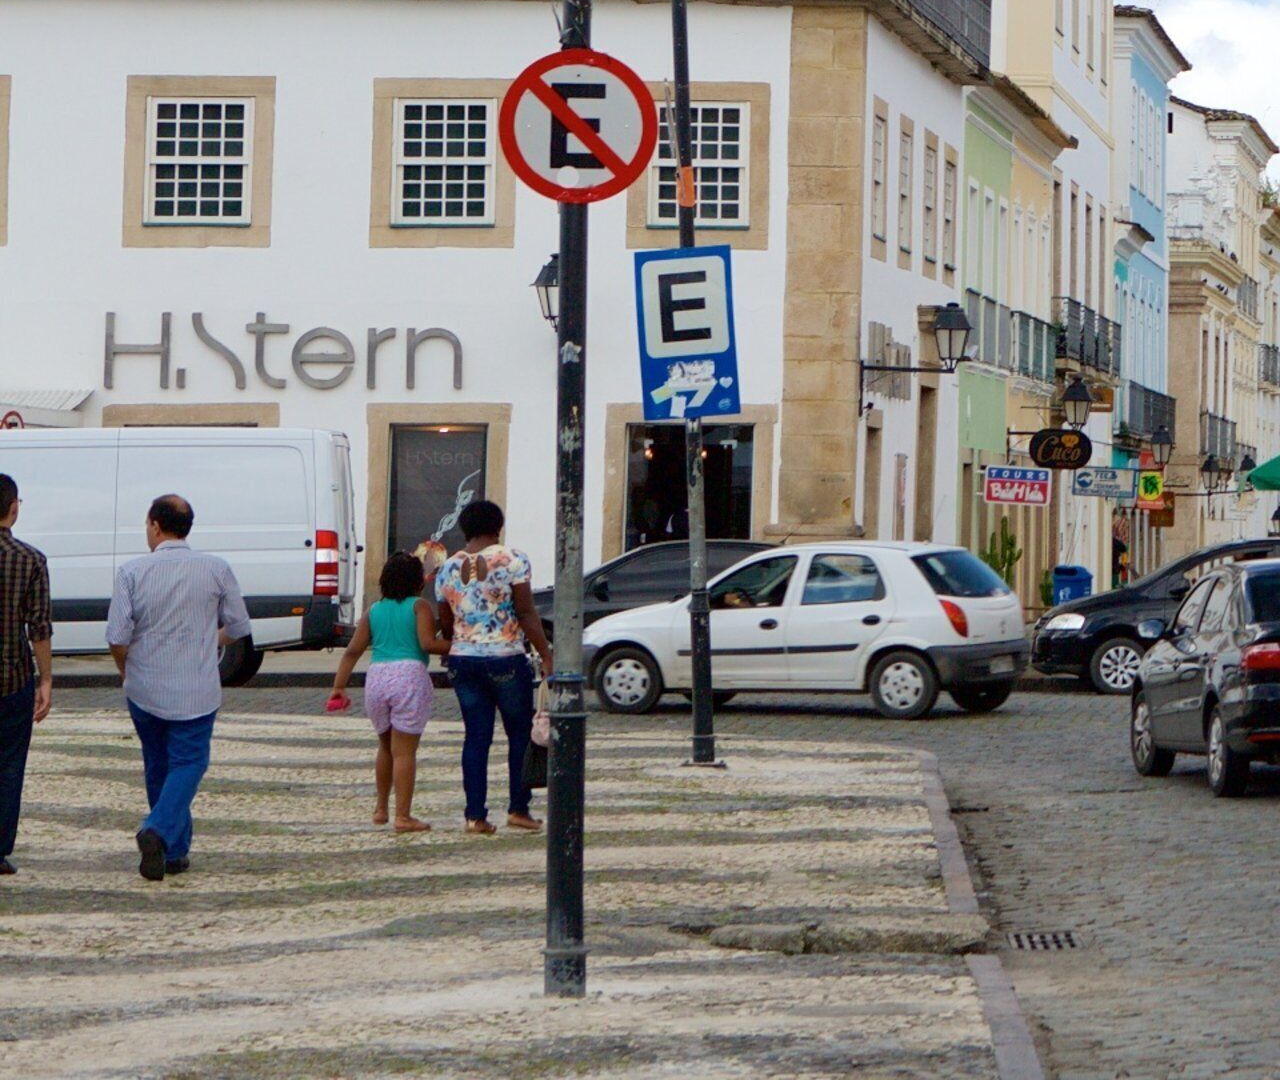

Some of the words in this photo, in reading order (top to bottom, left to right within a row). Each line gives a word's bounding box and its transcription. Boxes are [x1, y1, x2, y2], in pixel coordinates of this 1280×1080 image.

[550, 83, 606, 169] E
[658, 271, 712, 343] E
[1037, 437, 1081, 463] Cuco
[990, 469, 1047, 481] TOURS
